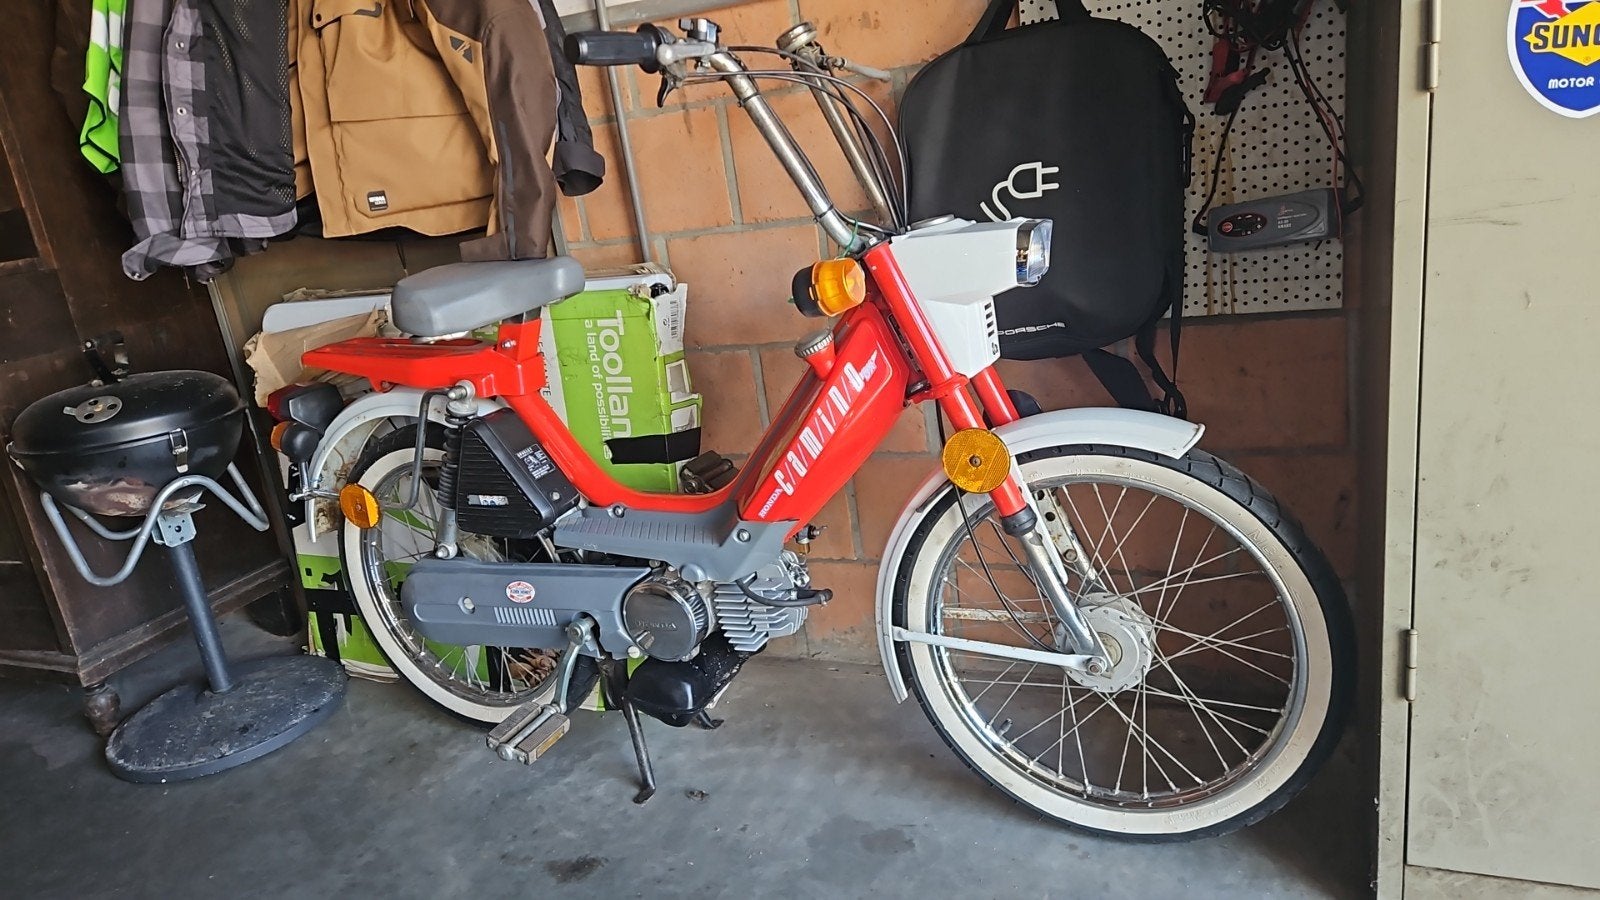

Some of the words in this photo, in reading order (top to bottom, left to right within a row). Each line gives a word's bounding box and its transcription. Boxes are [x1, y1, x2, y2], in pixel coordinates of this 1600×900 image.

[1547, 76, 1595, 90] MOTOR
[584, 319, 593, 329] a
[997, 321, 1066, 336] PORSCHE
[587, 332, 601, 362] land
[591, 365, 603, 380] of
[597, 309, 634, 438] Toollan
[758, 487, 783, 519] HONDA
